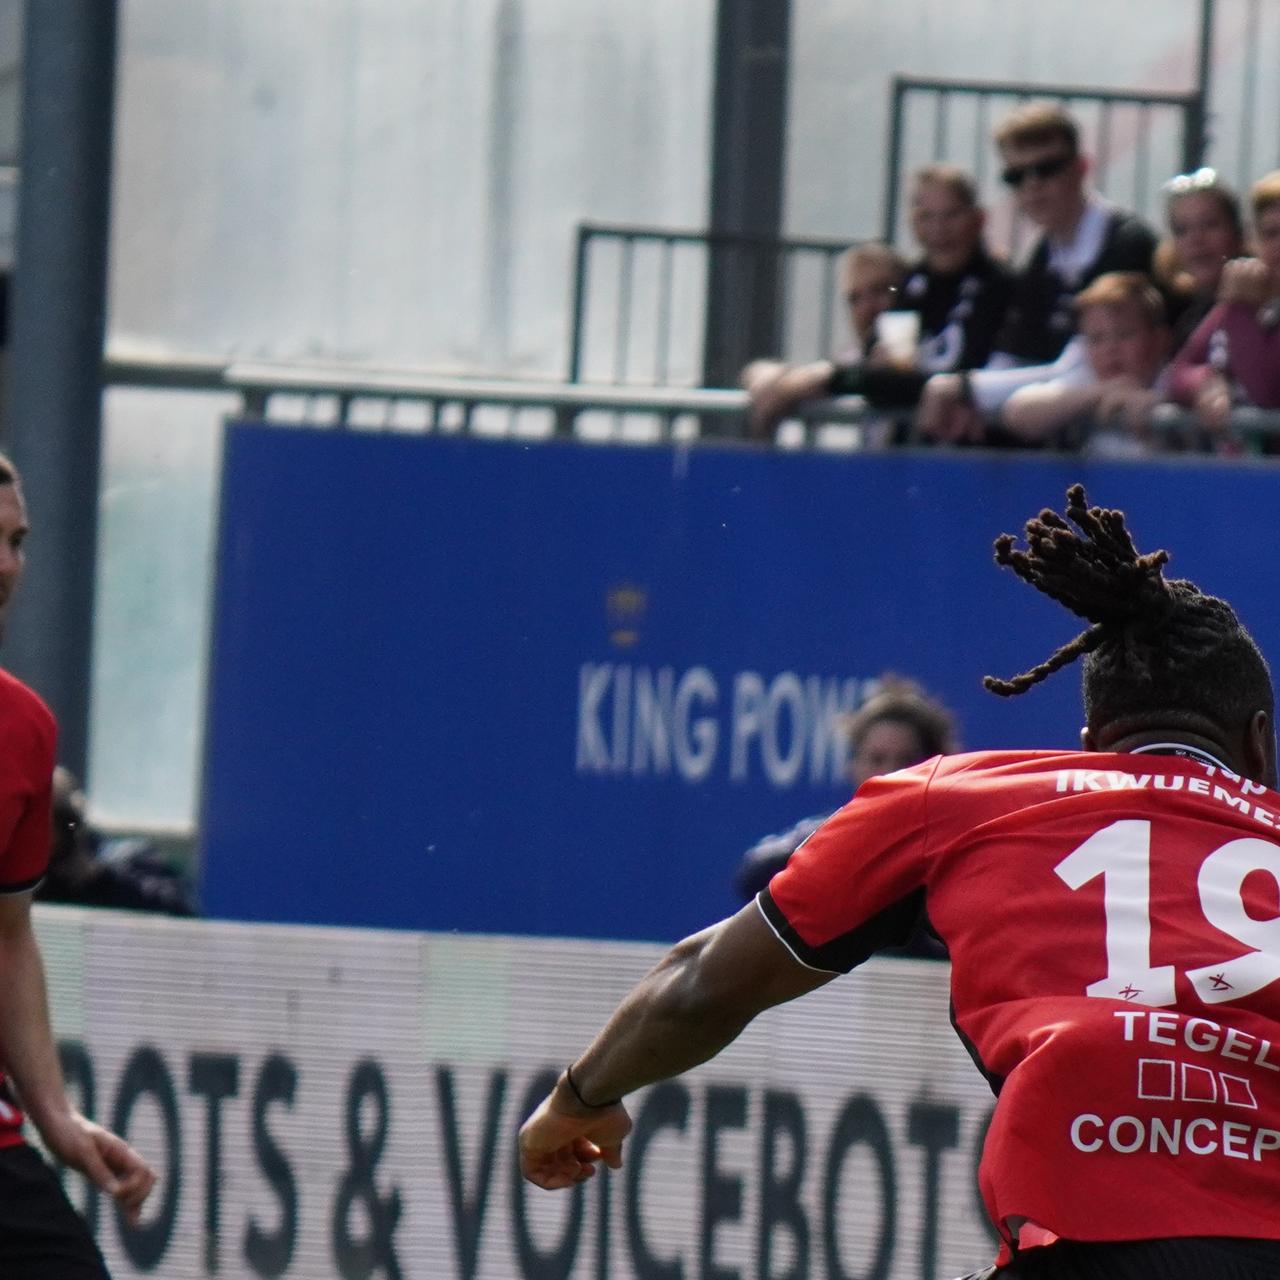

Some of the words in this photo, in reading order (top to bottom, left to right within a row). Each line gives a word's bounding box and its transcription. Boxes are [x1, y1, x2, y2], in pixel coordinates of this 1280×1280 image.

[575, 663, 721, 784] KING
[730, 670, 880, 787] POW
[1113, 1010, 1280, 1072] TEGEL
